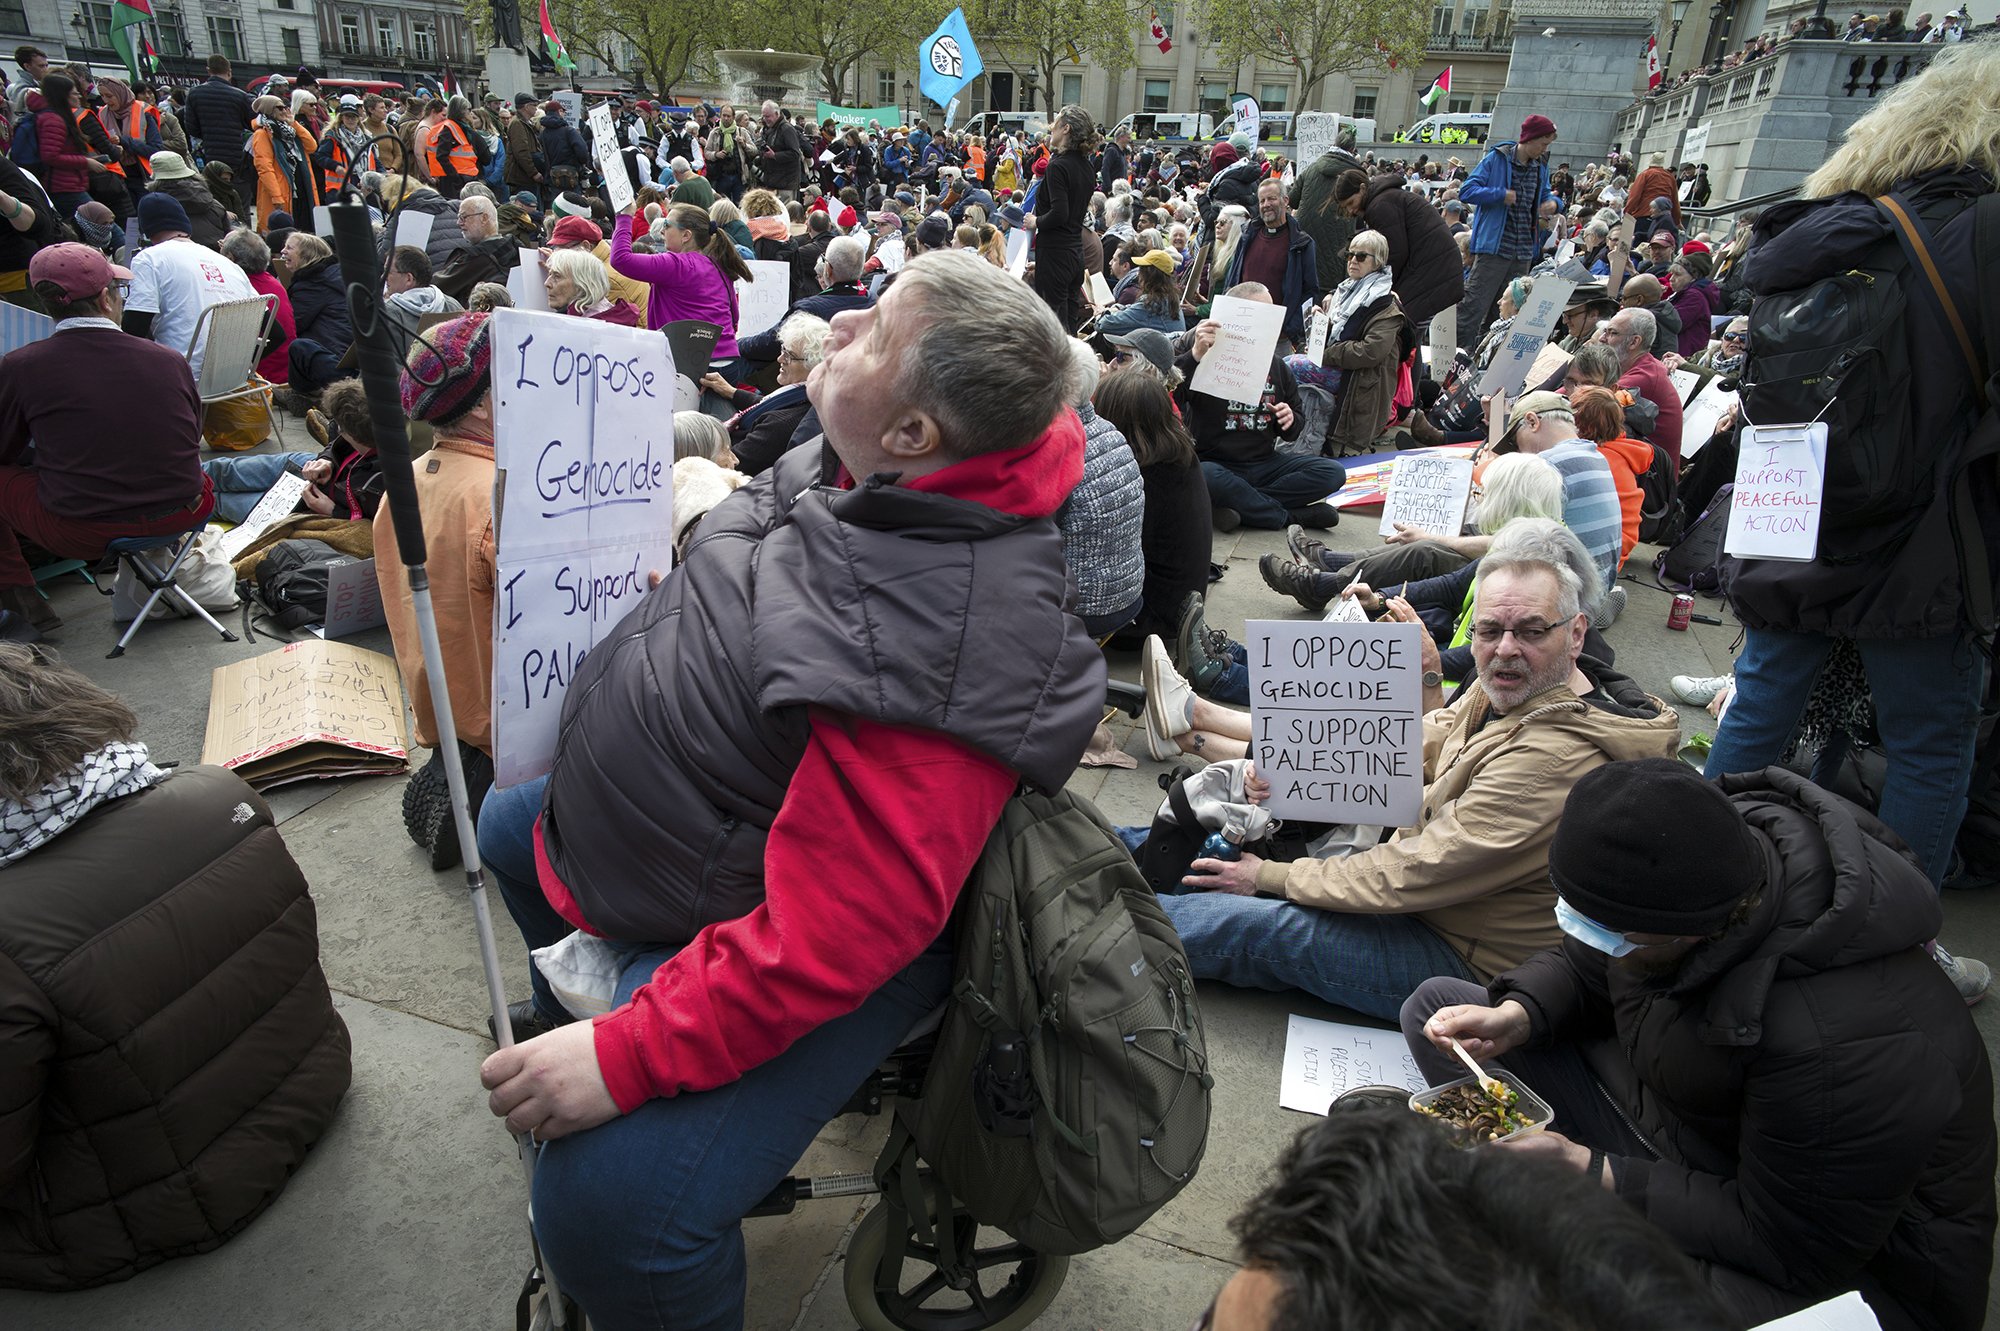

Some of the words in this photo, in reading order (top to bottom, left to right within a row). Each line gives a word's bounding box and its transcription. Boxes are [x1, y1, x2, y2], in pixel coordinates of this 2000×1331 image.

[830, 111, 866, 124] Quaker
[1236, 105, 1250, 122] jvl
[516, 333, 539, 390] I
[1407, 459, 1453, 477] OPPOSE
[1763, 445, 1780, 468] I
[536, 439, 662, 502] Genocide
[1394, 474, 1457, 491] GENOCIDE
[1400, 492, 1452, 510] SUPPORT
[1393, 505, 1456, 525] PALESTINE
[1743, 510, 1810, 535] ACTION
[333, 580, 357, 624] STOP
[504, 569, 527, 630] I
[554, 552, 643, 622] Support
[1262, 636, 1272, 668] I
[1292, 636, 1407, 671] OPPOSE
[225, 670, 389, 718] PALESTINE
[1260, 680, 1393, 702] GENOCIDE
[1260, 716, 1274, 742] I
[1287, 716, 1415, 748] SUPPORT
[1260, 745, 1413, 778] PALESTINE
[1286, 780, 1388, 808] ACTION
[1353, 1037, 1372, 1050] I
[1303, 1046, 1321, 1087] ACTION
